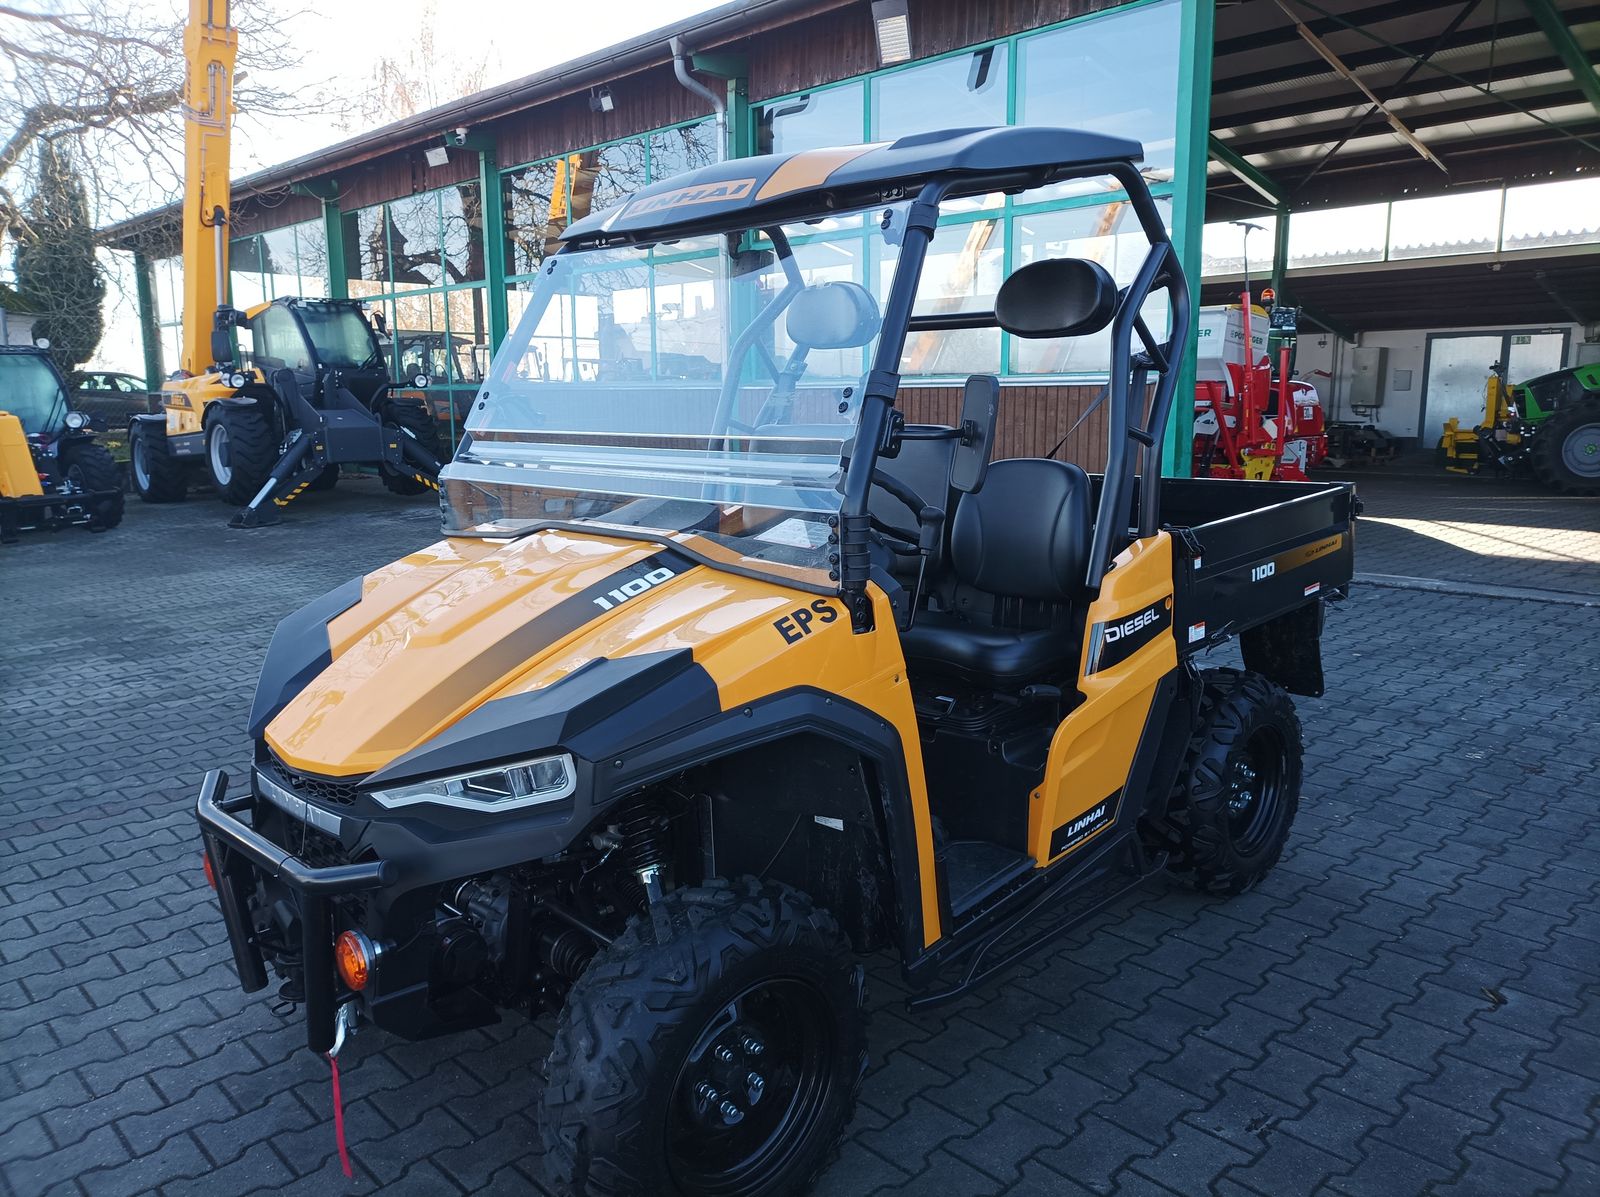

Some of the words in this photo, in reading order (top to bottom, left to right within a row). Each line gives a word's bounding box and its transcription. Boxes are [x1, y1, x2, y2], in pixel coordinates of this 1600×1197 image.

[593, 567, 675, 611] 1100
[1251, 561, 1275, 582] 1100
[772, 599, 838, 645] EPS
[1104, 608, 1160, 643] DIESEL
[1067, 805, 1106, 837] LINHAI
